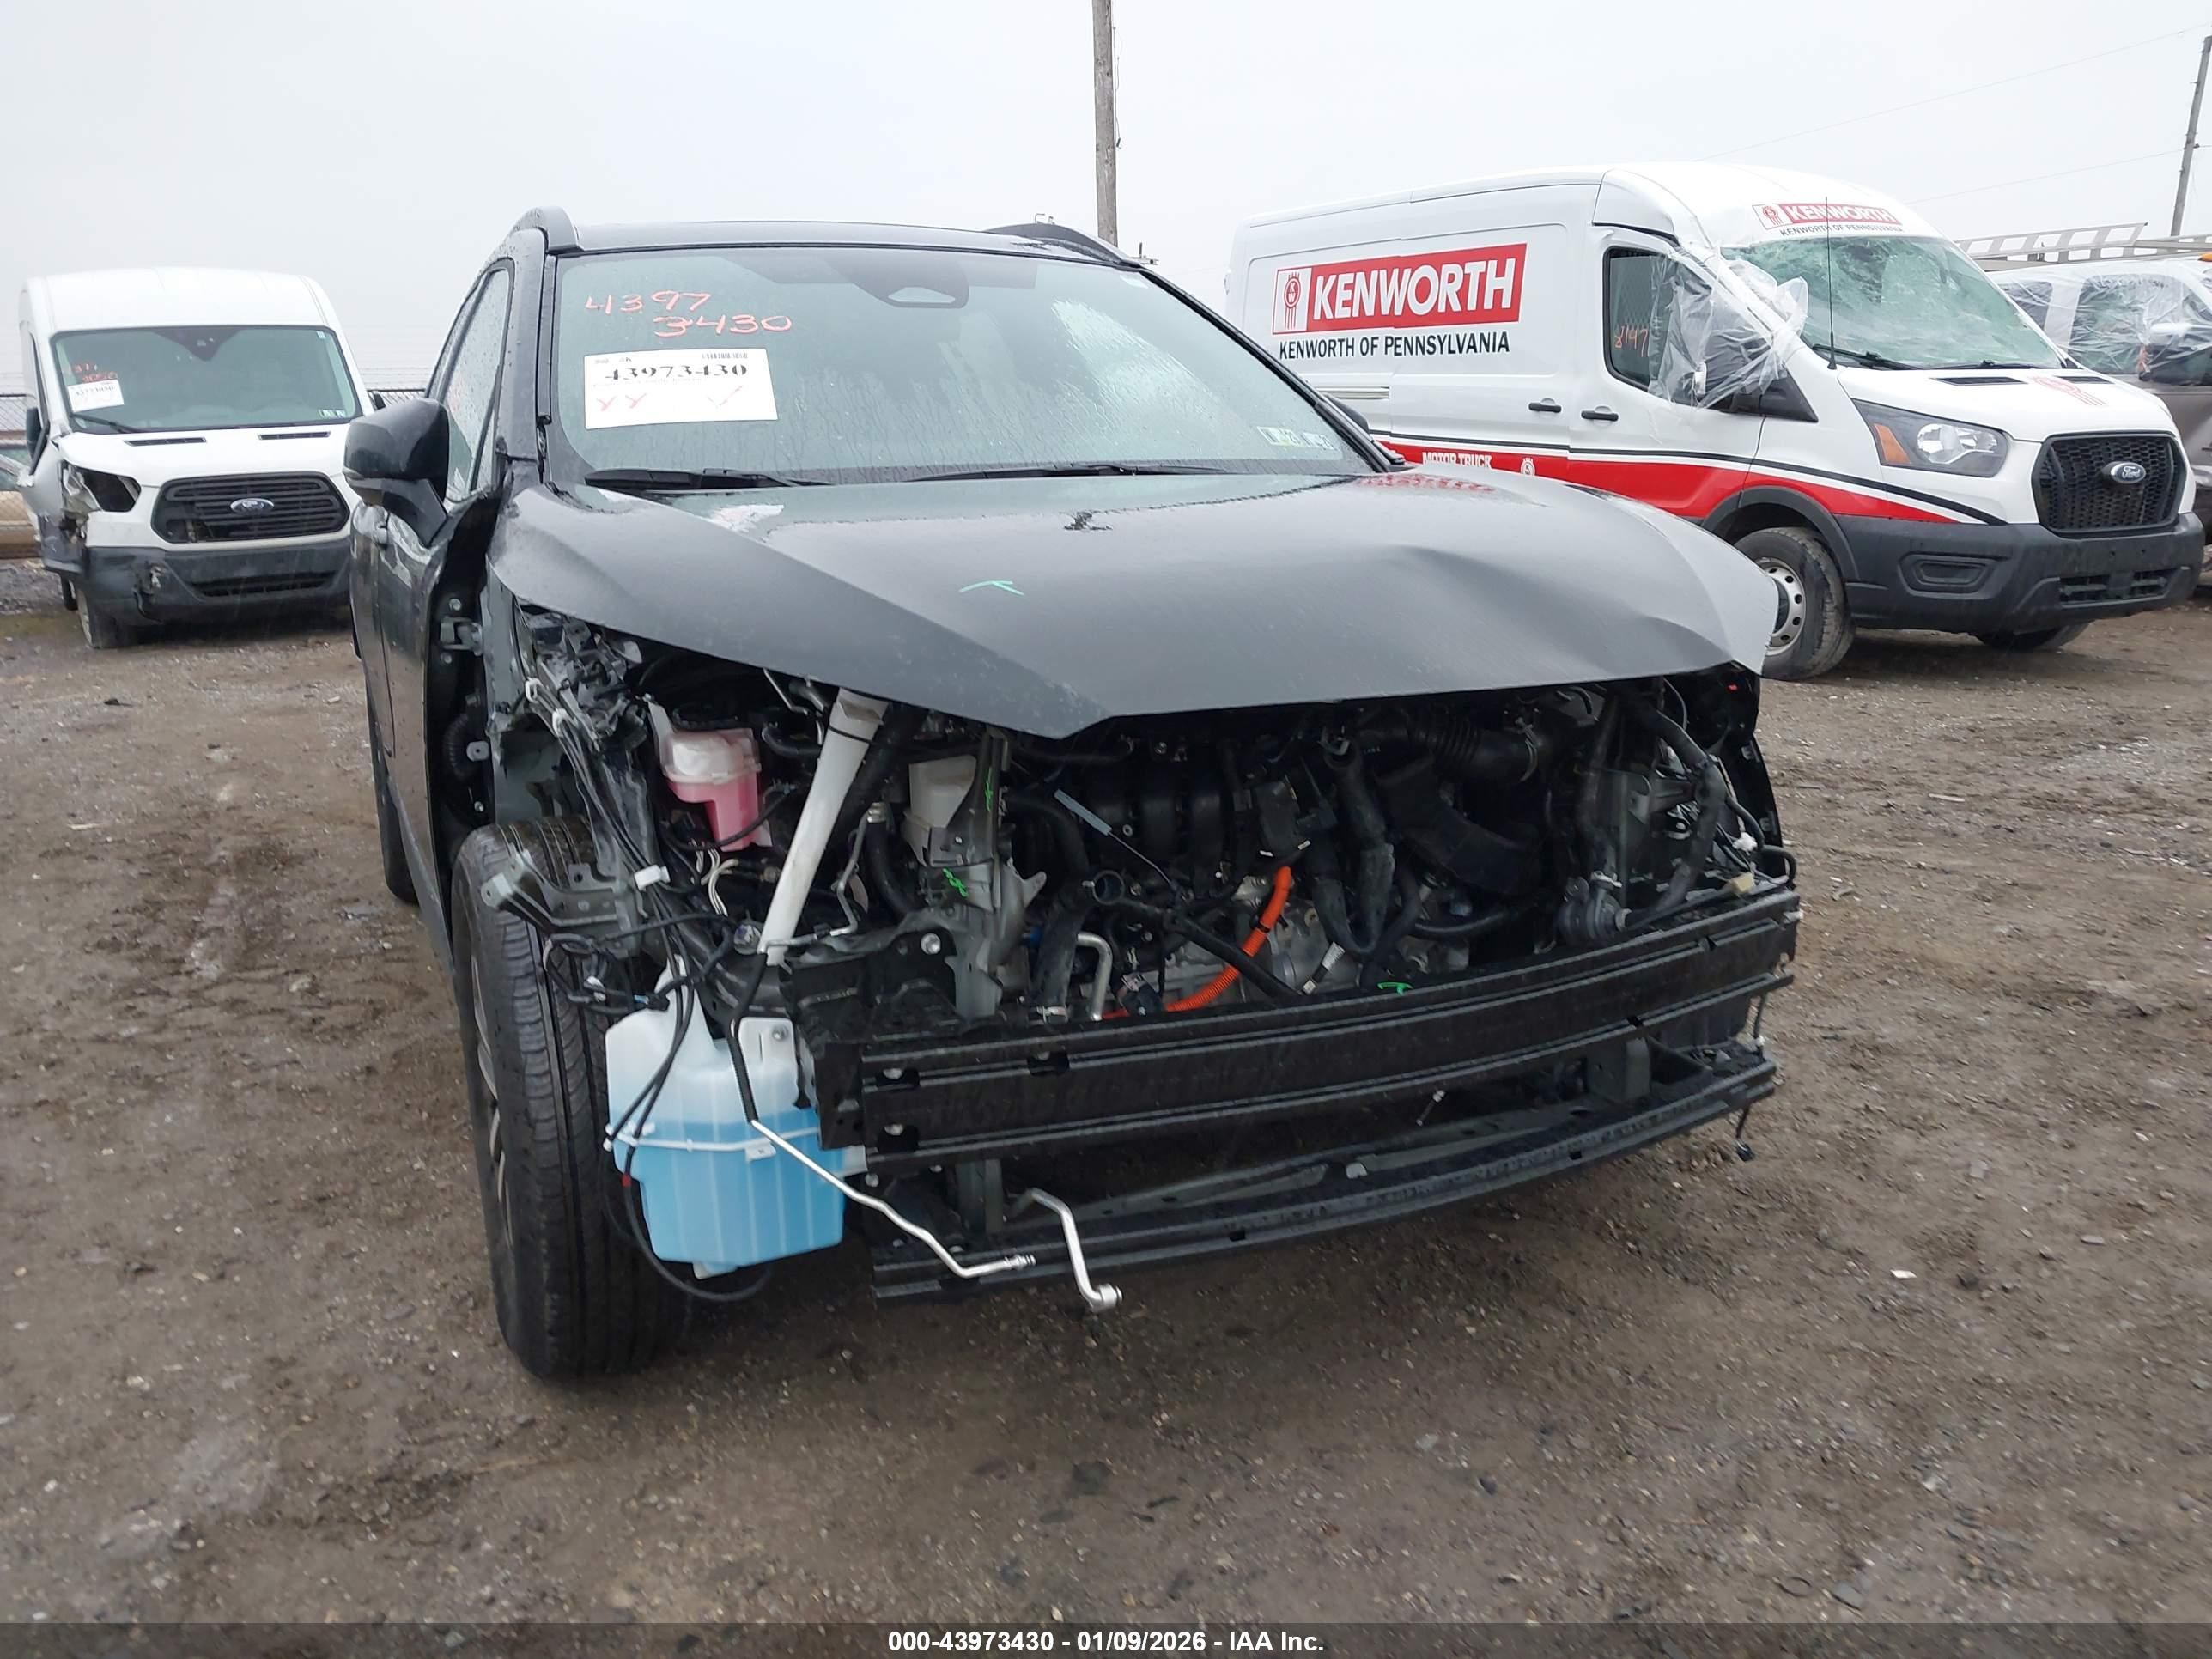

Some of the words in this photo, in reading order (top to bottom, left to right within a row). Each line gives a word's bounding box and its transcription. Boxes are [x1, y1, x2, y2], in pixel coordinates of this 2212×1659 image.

[1784, 205, 1897, 222] KENWORTH
[1779, 224, 1831, 236] KENWORTH
[1313, 258, 1516, 321] KENWORTH
[585, 290, 712, 315] 4397
[653, 314, 793, 337] 3430
[1279, 337, 1355, 360] KENWORTH
[1360, 336, 1379, 356] OF
[1384, 331, 1510, 356] PENNSYLVANIA
[604, 364, 747, 380] 43973430
